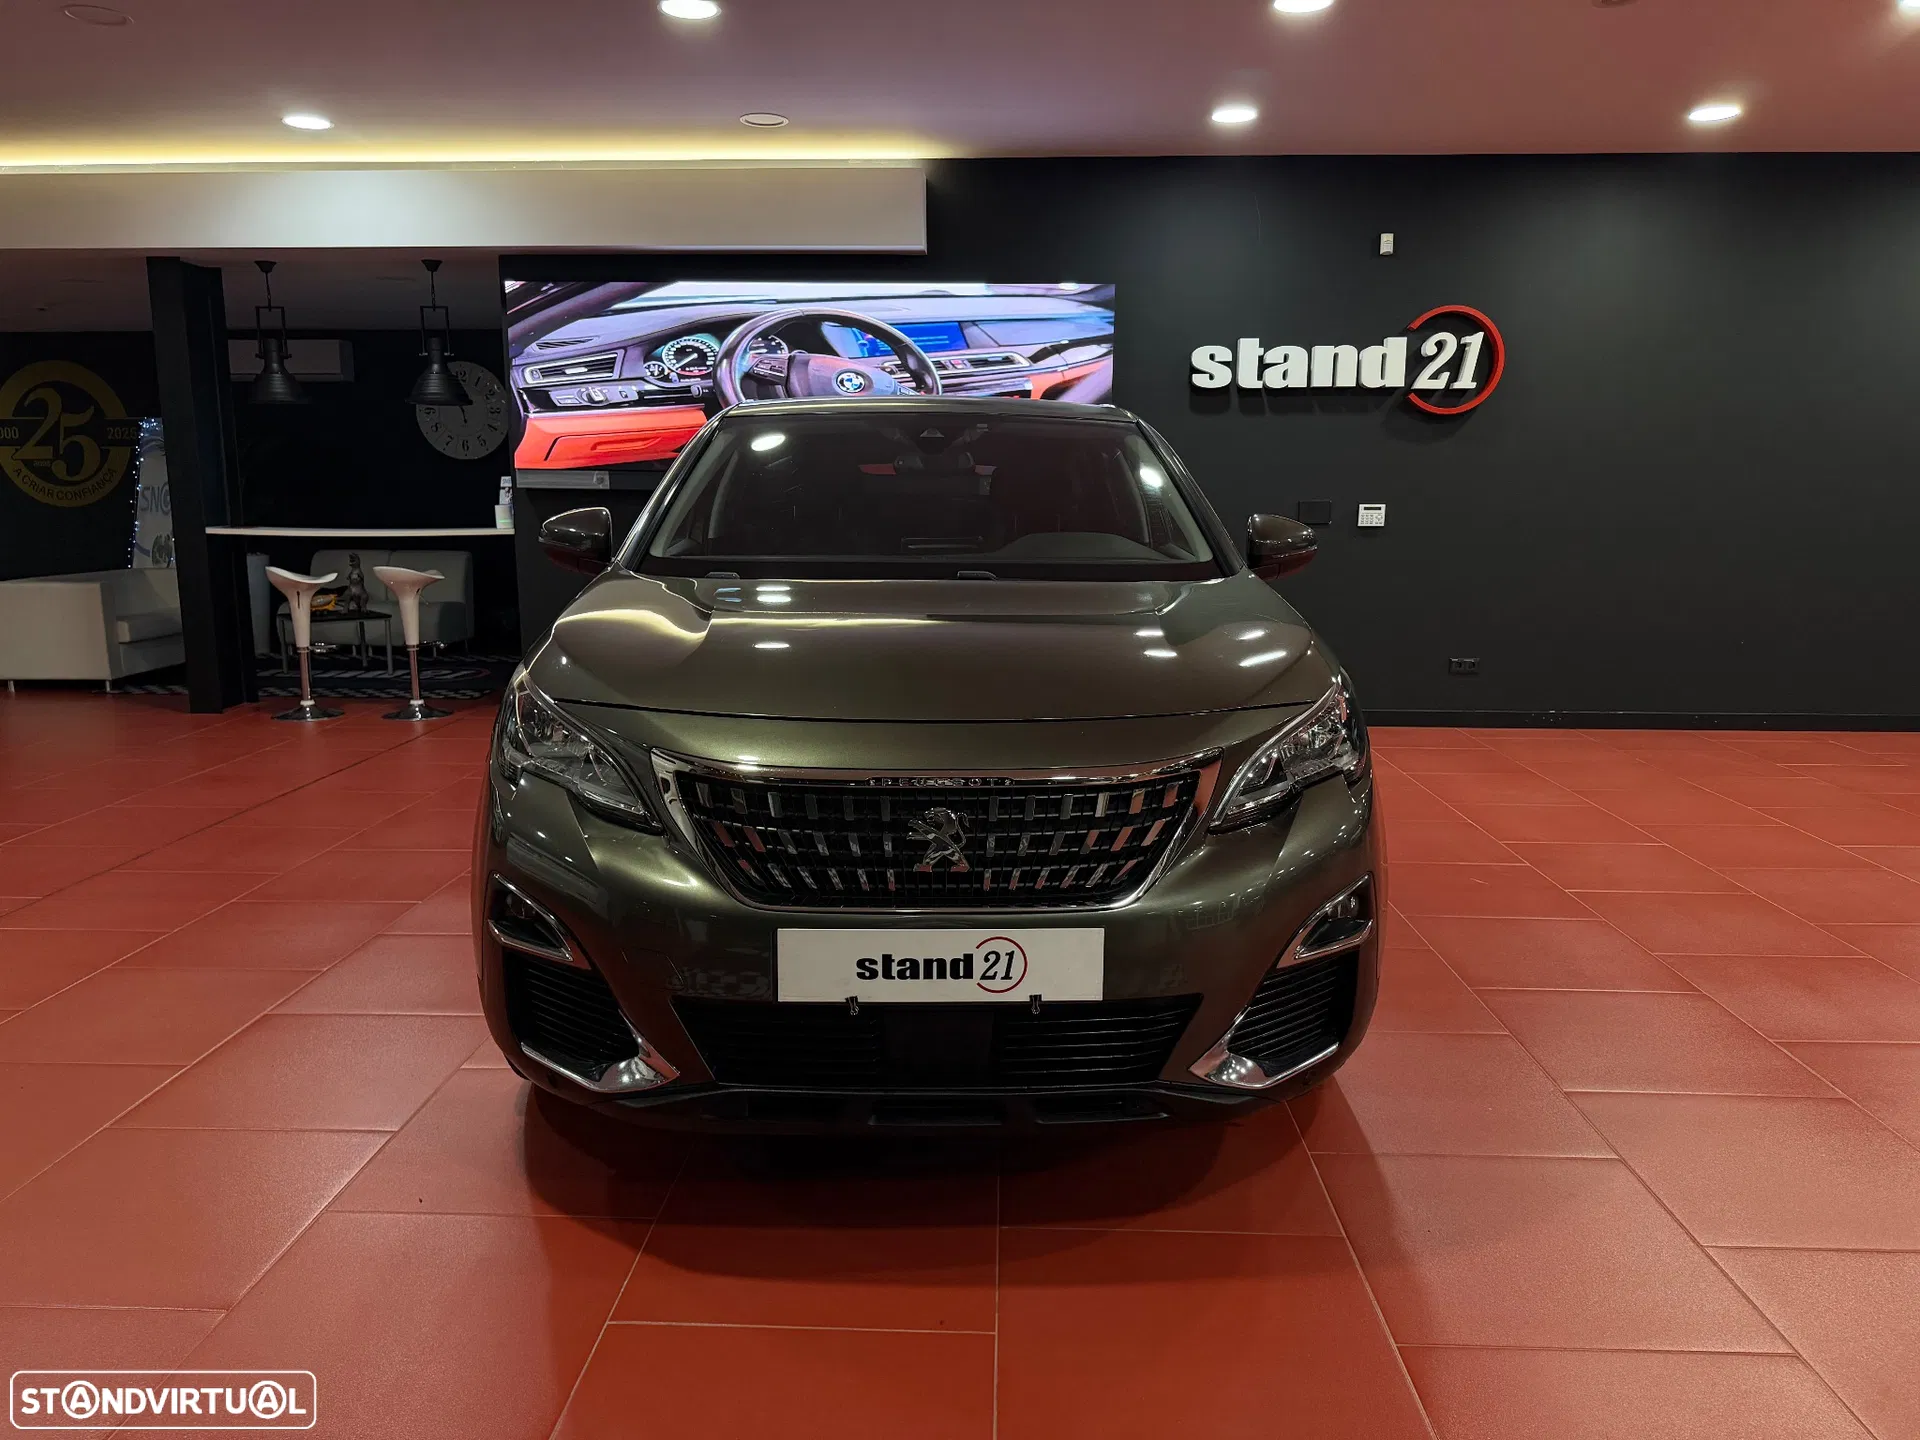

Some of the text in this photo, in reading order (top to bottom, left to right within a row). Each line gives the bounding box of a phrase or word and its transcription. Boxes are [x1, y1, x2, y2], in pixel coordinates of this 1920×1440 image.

[1191, 331, 1485, 390] stand 21
[489, 406, 501, 414] 3
[431, 422, 441, 432] 8
[11, 387, 101, 482] 25
[446, 435, 454, 446] 7
[477, 434, 487, 447] 5
[462, 439, 470, 451] 6
[22, 474, 54, 500] CRIAR
[56, 468, 118, 501] CONFIANÇA
[856, 949, 1016, 981] stand 21
